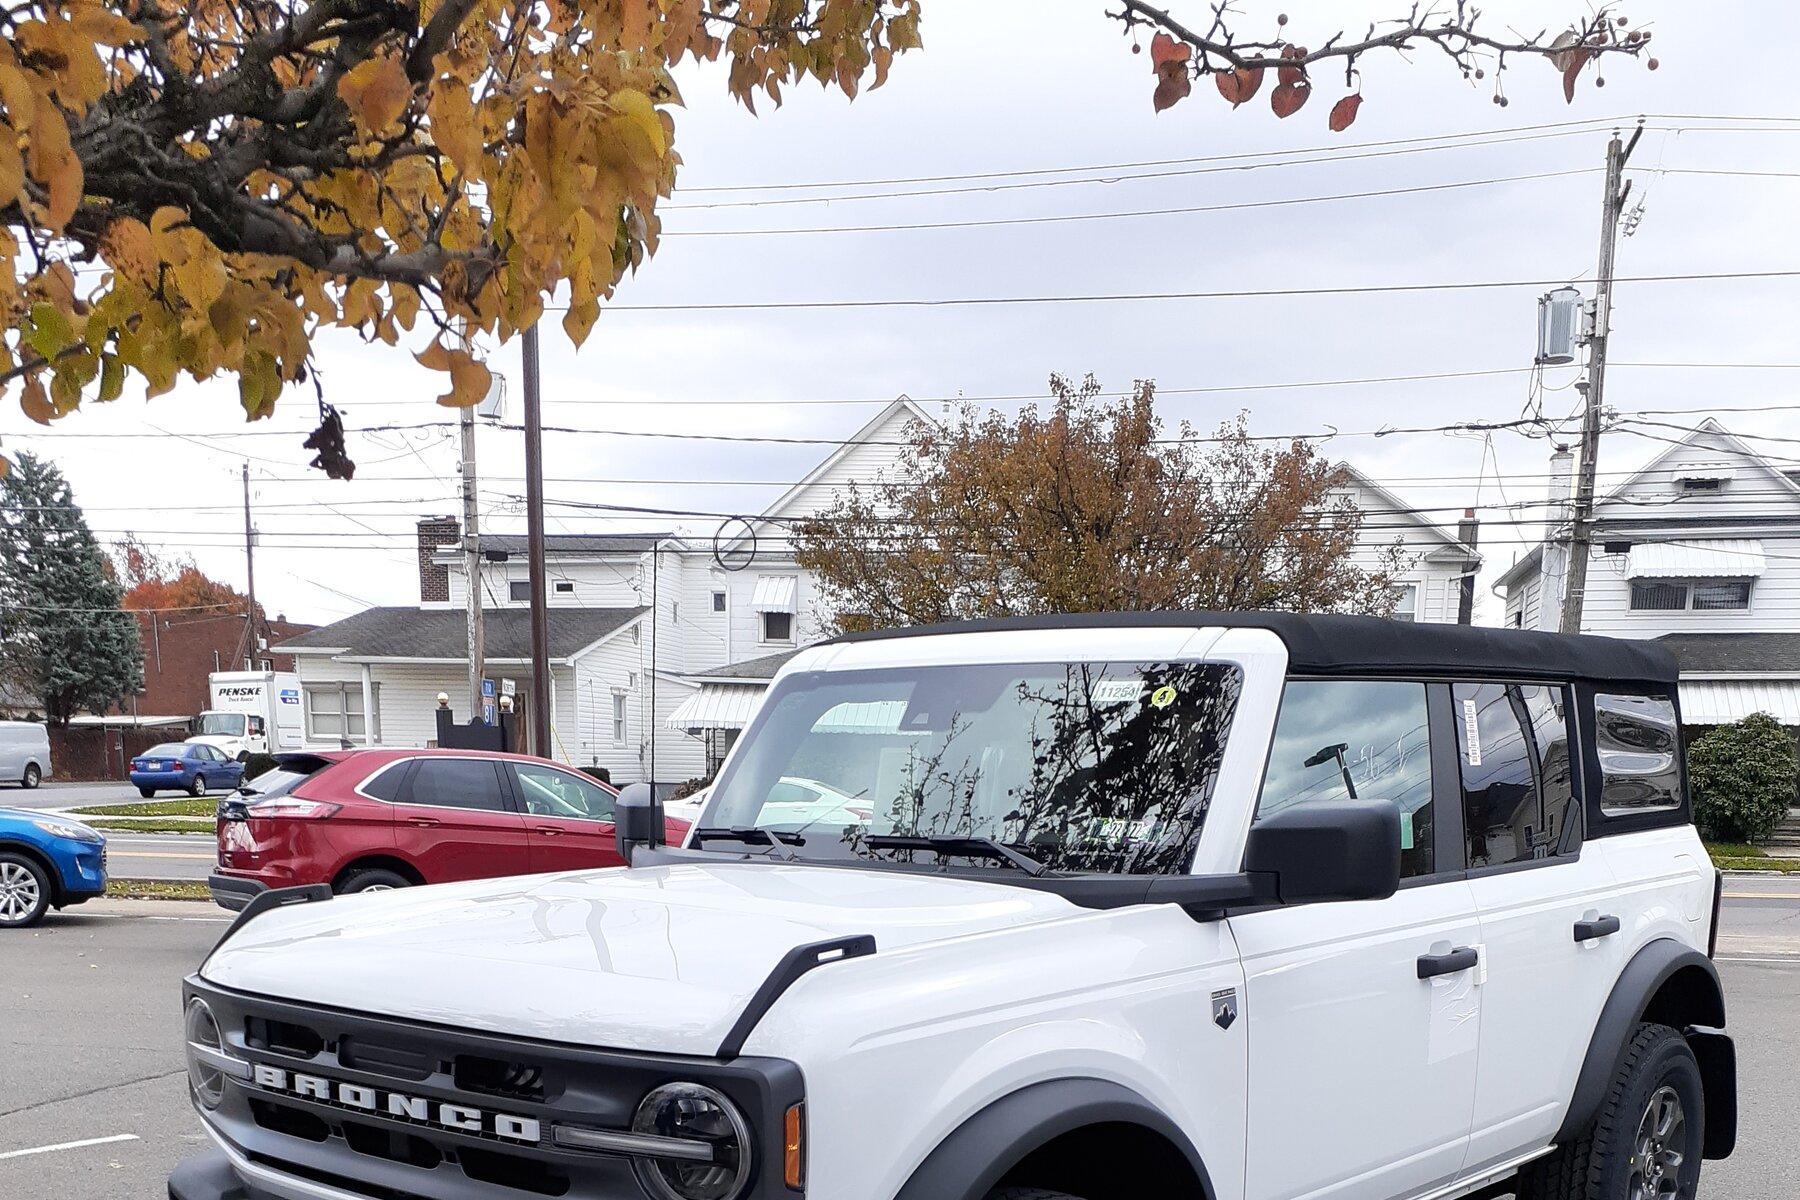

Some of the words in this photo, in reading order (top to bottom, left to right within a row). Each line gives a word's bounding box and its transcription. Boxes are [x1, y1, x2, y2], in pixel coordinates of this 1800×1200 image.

[219, 688, 261, 696] PENSKE
[484, 705, 493, 723] 81
[254, 1063, 541, 1142] BRONCO
